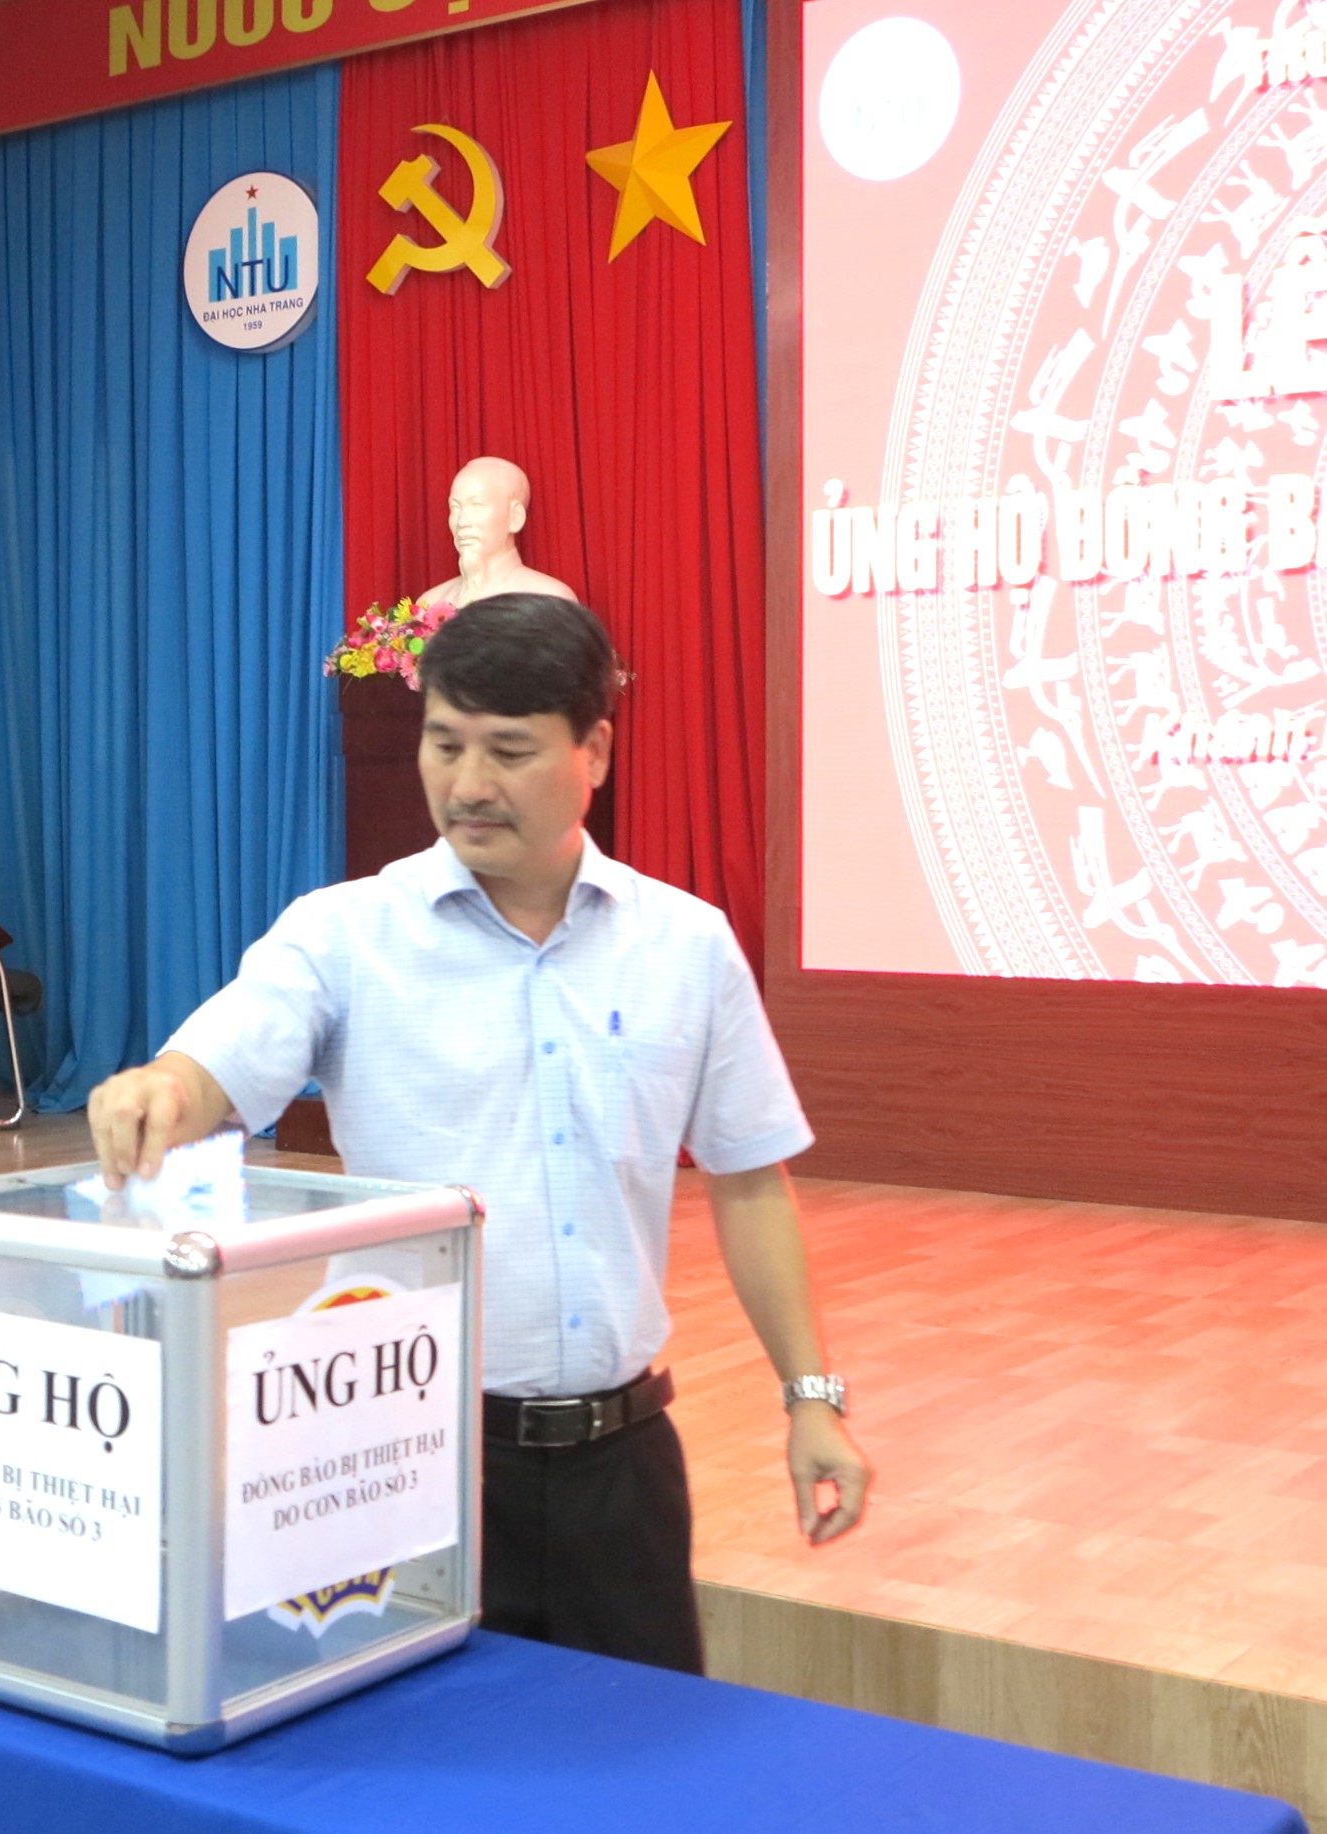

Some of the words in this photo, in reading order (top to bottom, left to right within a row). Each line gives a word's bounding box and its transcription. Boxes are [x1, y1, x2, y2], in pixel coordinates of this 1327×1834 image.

[217, 254, 289, 301] NTU
[203, 310, 220, 323] ĐẠI
[223, 306, 244, 321] HỌC
[246, 303, 266, 316] NHA
[269, 297, 304, 312] TRANG
[243, 321, 263, 331] 1959
[252, 1350, 359, 1426] ỦNG
[371, 1324, 439, 1401] HỘ
[40, 1372, 131, 1454] HỘ
[341, 1452, 358, 1477] BỊ
[363, 1437, 412, 1469] THIỆT
[416, 1428, 445, 1455] HẠI
[2, 1464, 22, 1492] BỊ
[30, 1470, 94, 1505] THIỆT
[101, 1488, 141, 1518] HẠI
[274, 1505, 300, 1531] DO
[345, 1479, 382, 1509] BÃO
[410, 1470, 419, 1490] 3
[92, 1521, 103, 1542] 3
